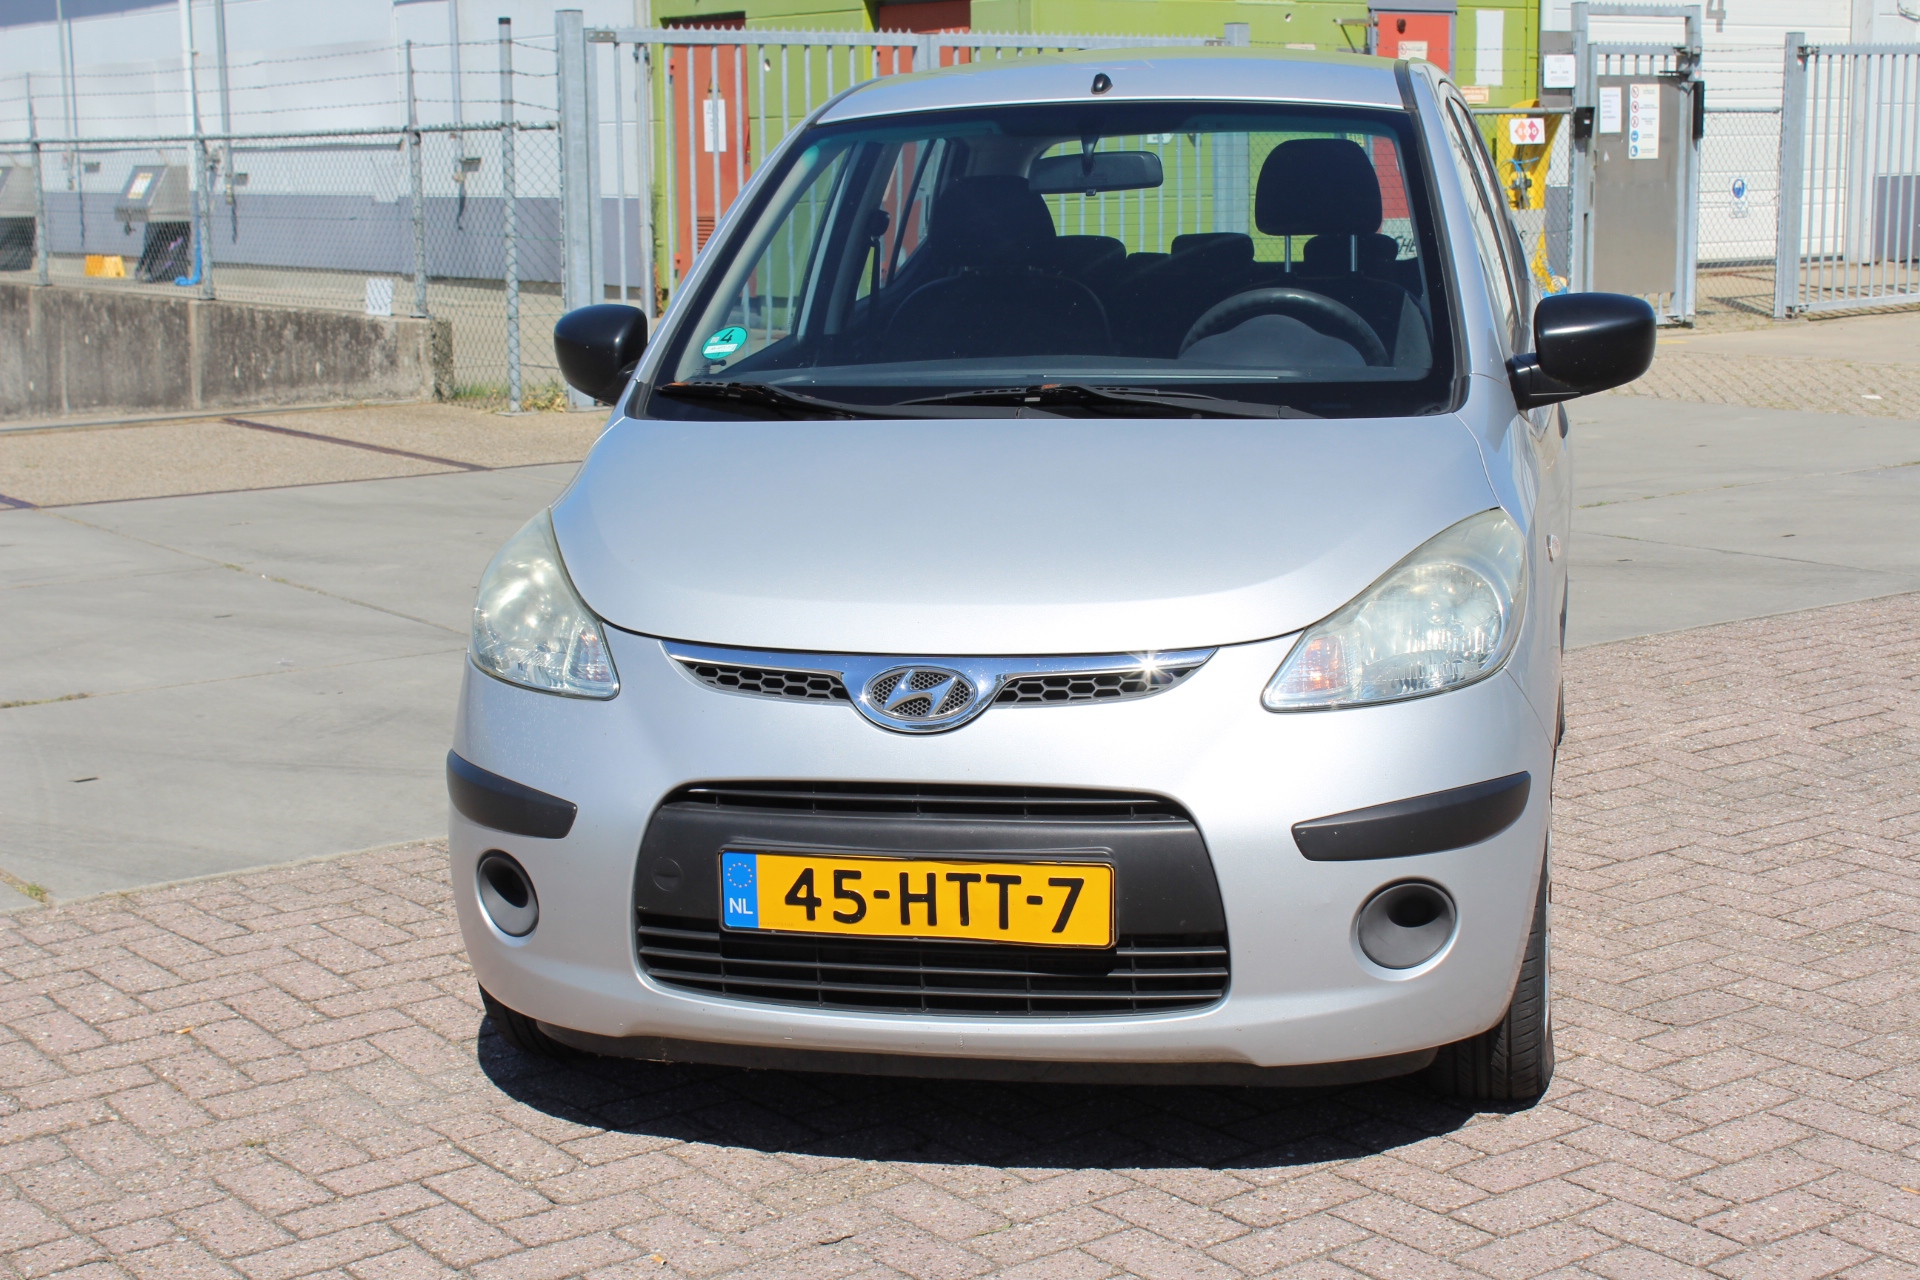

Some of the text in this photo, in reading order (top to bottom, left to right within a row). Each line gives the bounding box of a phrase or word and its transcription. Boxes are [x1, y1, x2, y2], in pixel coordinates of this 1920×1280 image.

[1706, 0, 1726, 33] 4
[721, 329, 734, 343] 4
[729, 897, 754, 916] NL
[785, 867, 1085, 933] 45-HTT-7
